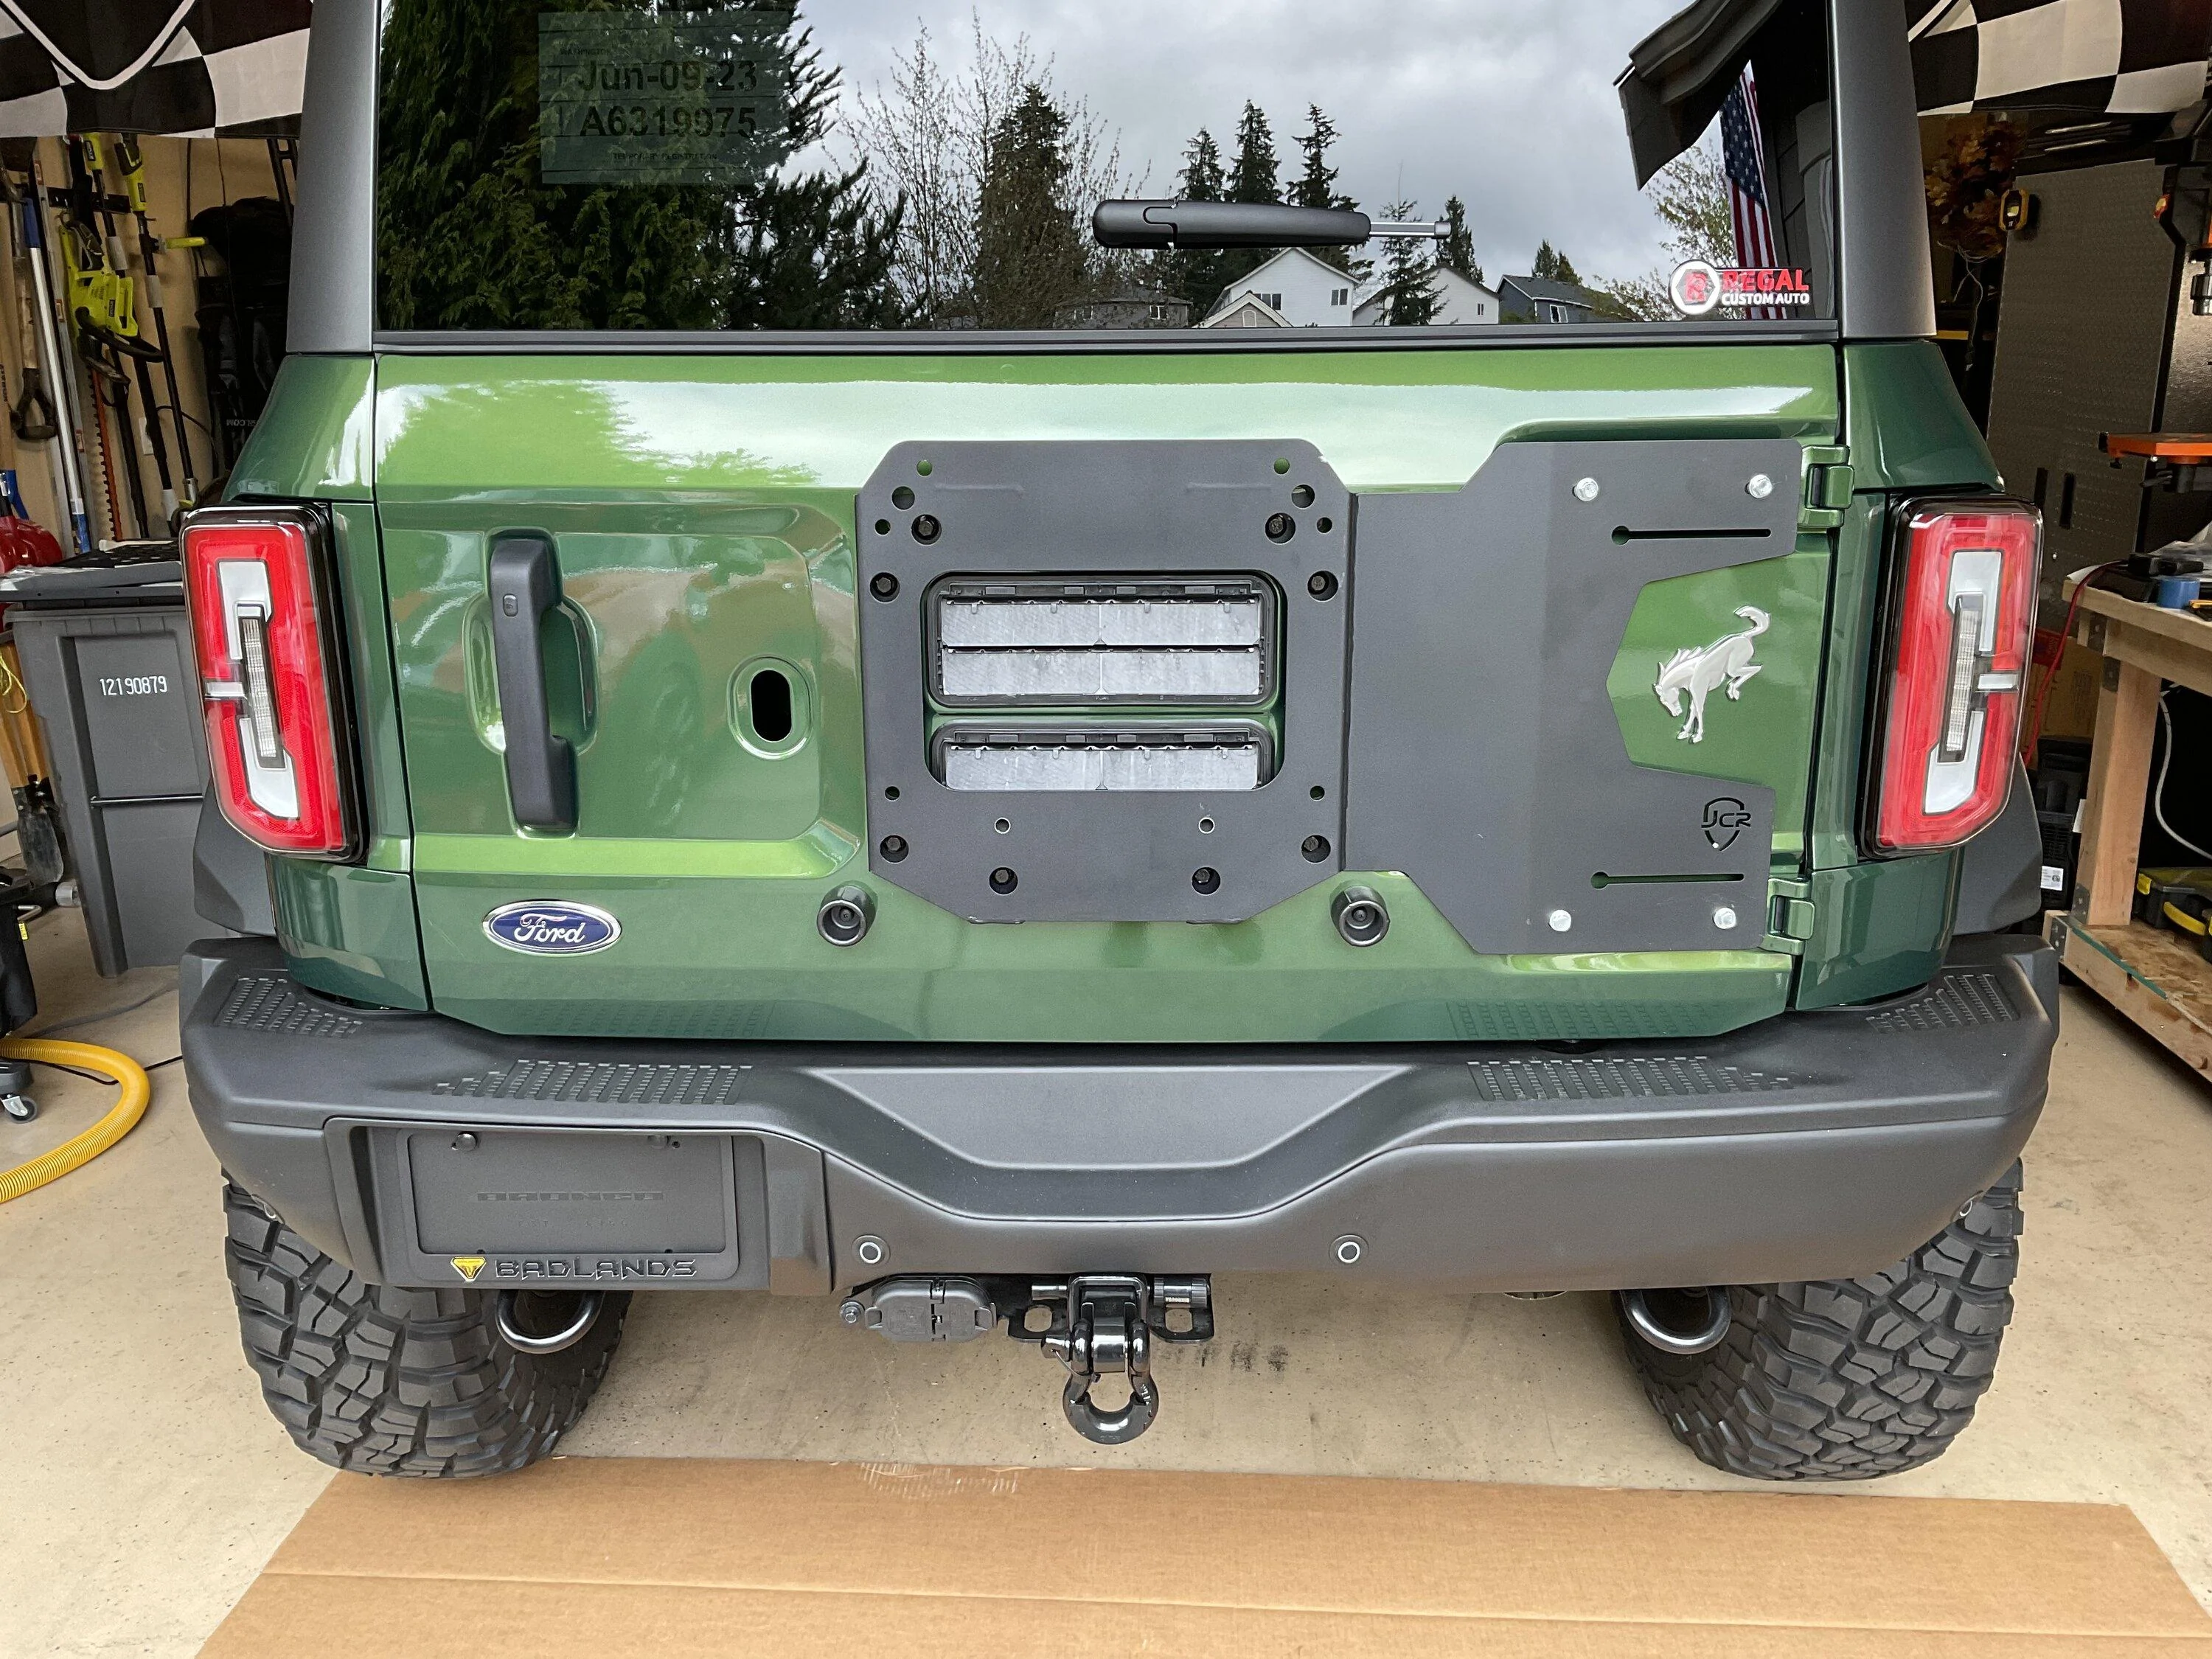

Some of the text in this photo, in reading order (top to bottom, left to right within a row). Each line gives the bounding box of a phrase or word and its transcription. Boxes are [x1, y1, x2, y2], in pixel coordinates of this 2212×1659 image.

[577, 60, 757, 91] Jun-09-23
[1722, 269, 1809, 291] REGAL
[1722, 293, 1810, 305] CUSTOM AUTO
[99, 675, 168, 696] 12190879
[1700, 810, 1751, 828] JCR
[514, 913, 586, 943] Ford
[494, 1258, 698, 1281] BADLANDS
